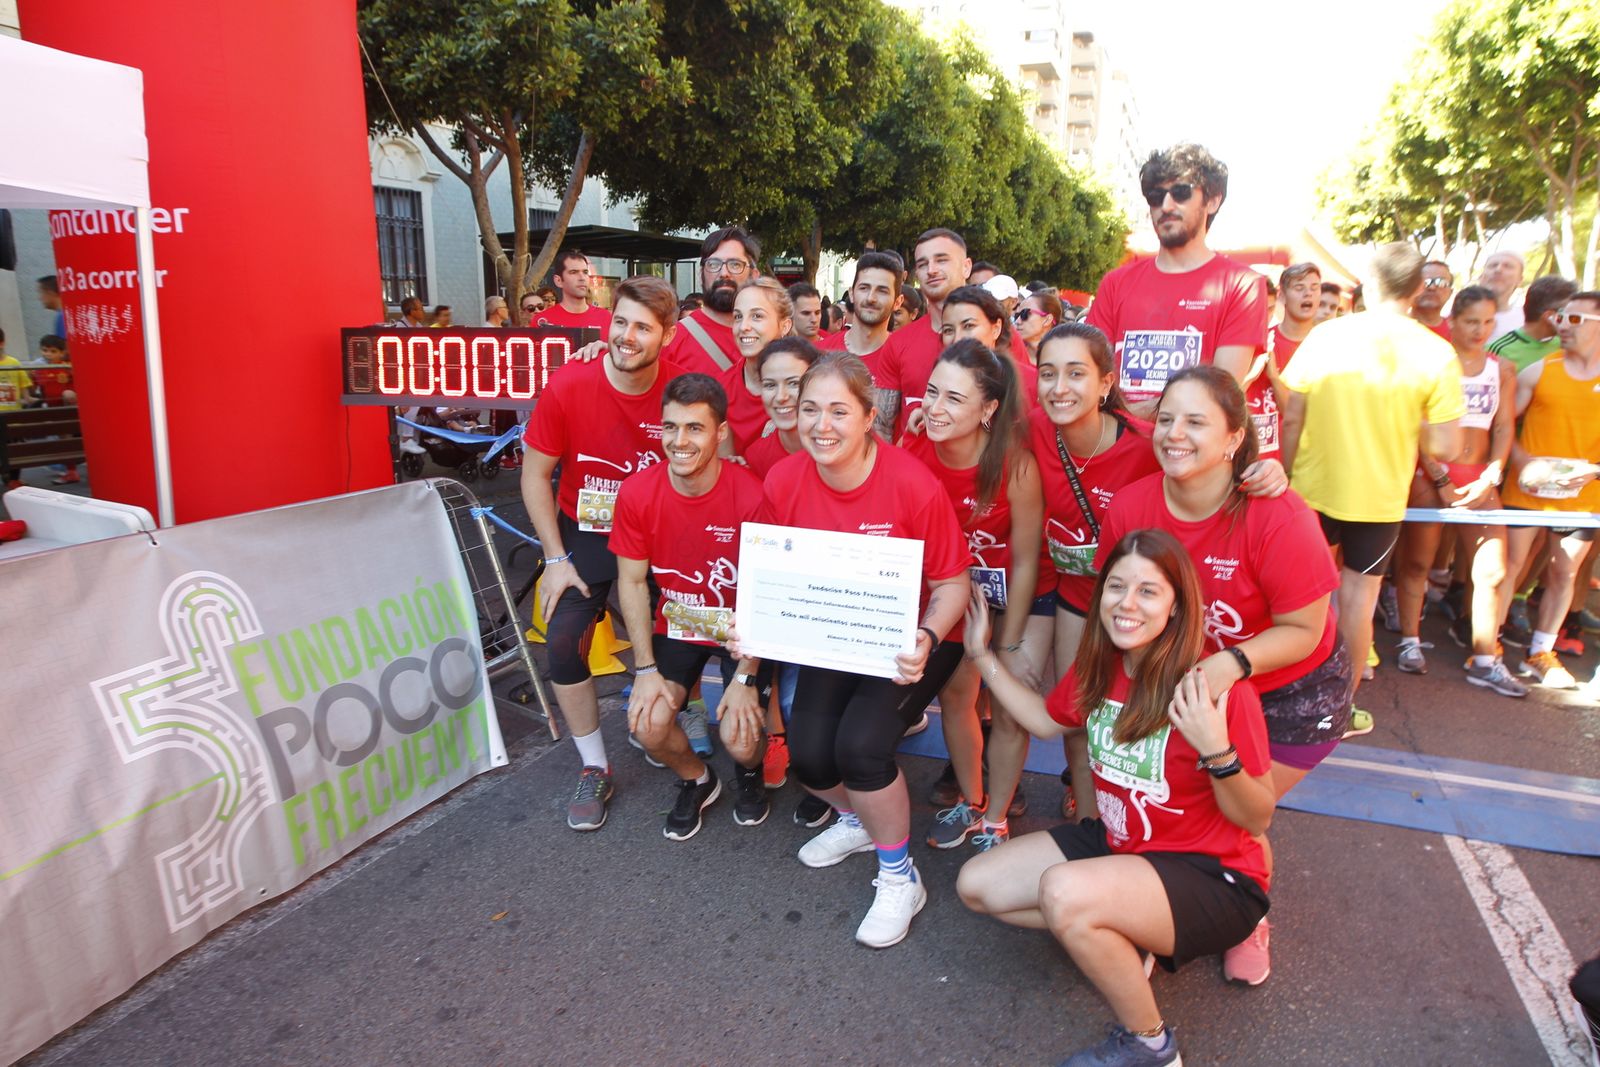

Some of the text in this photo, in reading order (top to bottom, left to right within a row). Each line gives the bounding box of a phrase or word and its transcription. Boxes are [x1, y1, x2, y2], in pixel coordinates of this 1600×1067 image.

[1127, 349, 1185, 371] 2020
[231, 575, 471, 717] FUNDACIÓN
[256, 637, 484, 801] POCO
[283, 698, 490, 866] FRECUENT
[1092, 722, 1147, 763] 1024
